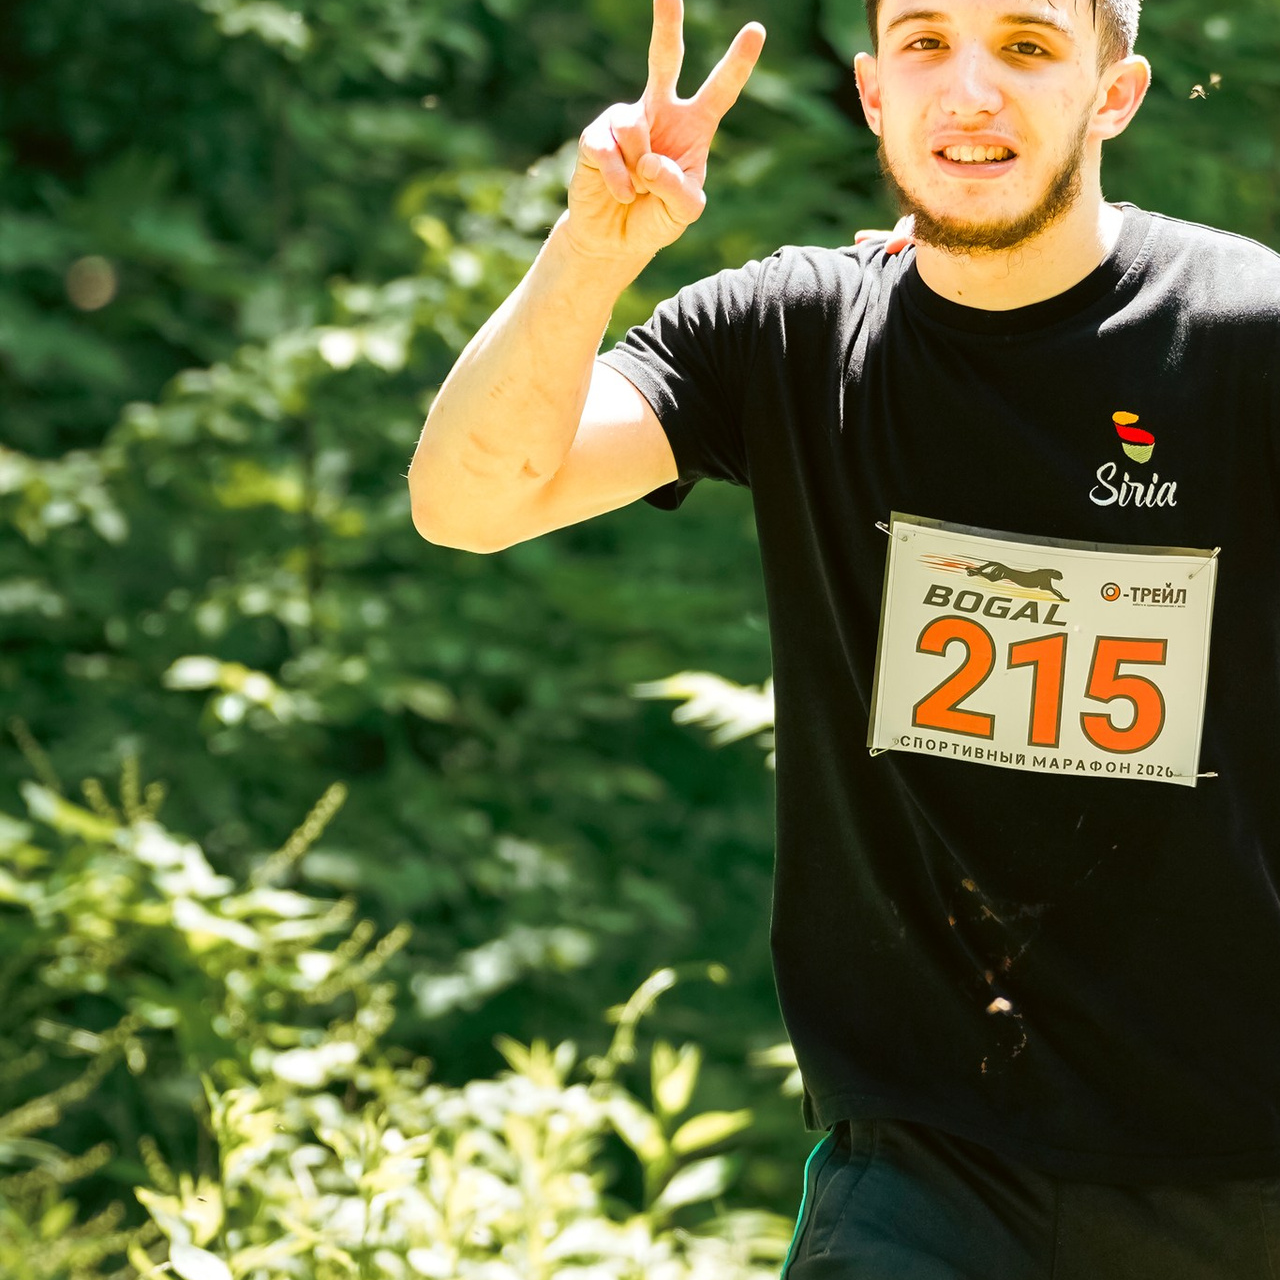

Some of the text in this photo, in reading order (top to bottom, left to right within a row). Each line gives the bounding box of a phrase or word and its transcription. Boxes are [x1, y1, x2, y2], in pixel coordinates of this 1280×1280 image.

[1089, 461, 1178, 507] Siria
[922, 583, 1068, 627] BOGAL
[911, 614, 1169, 755] 215
[900, 735, 1174, 778] СПОРТИВНЫЙ МАРАФОН 2026
